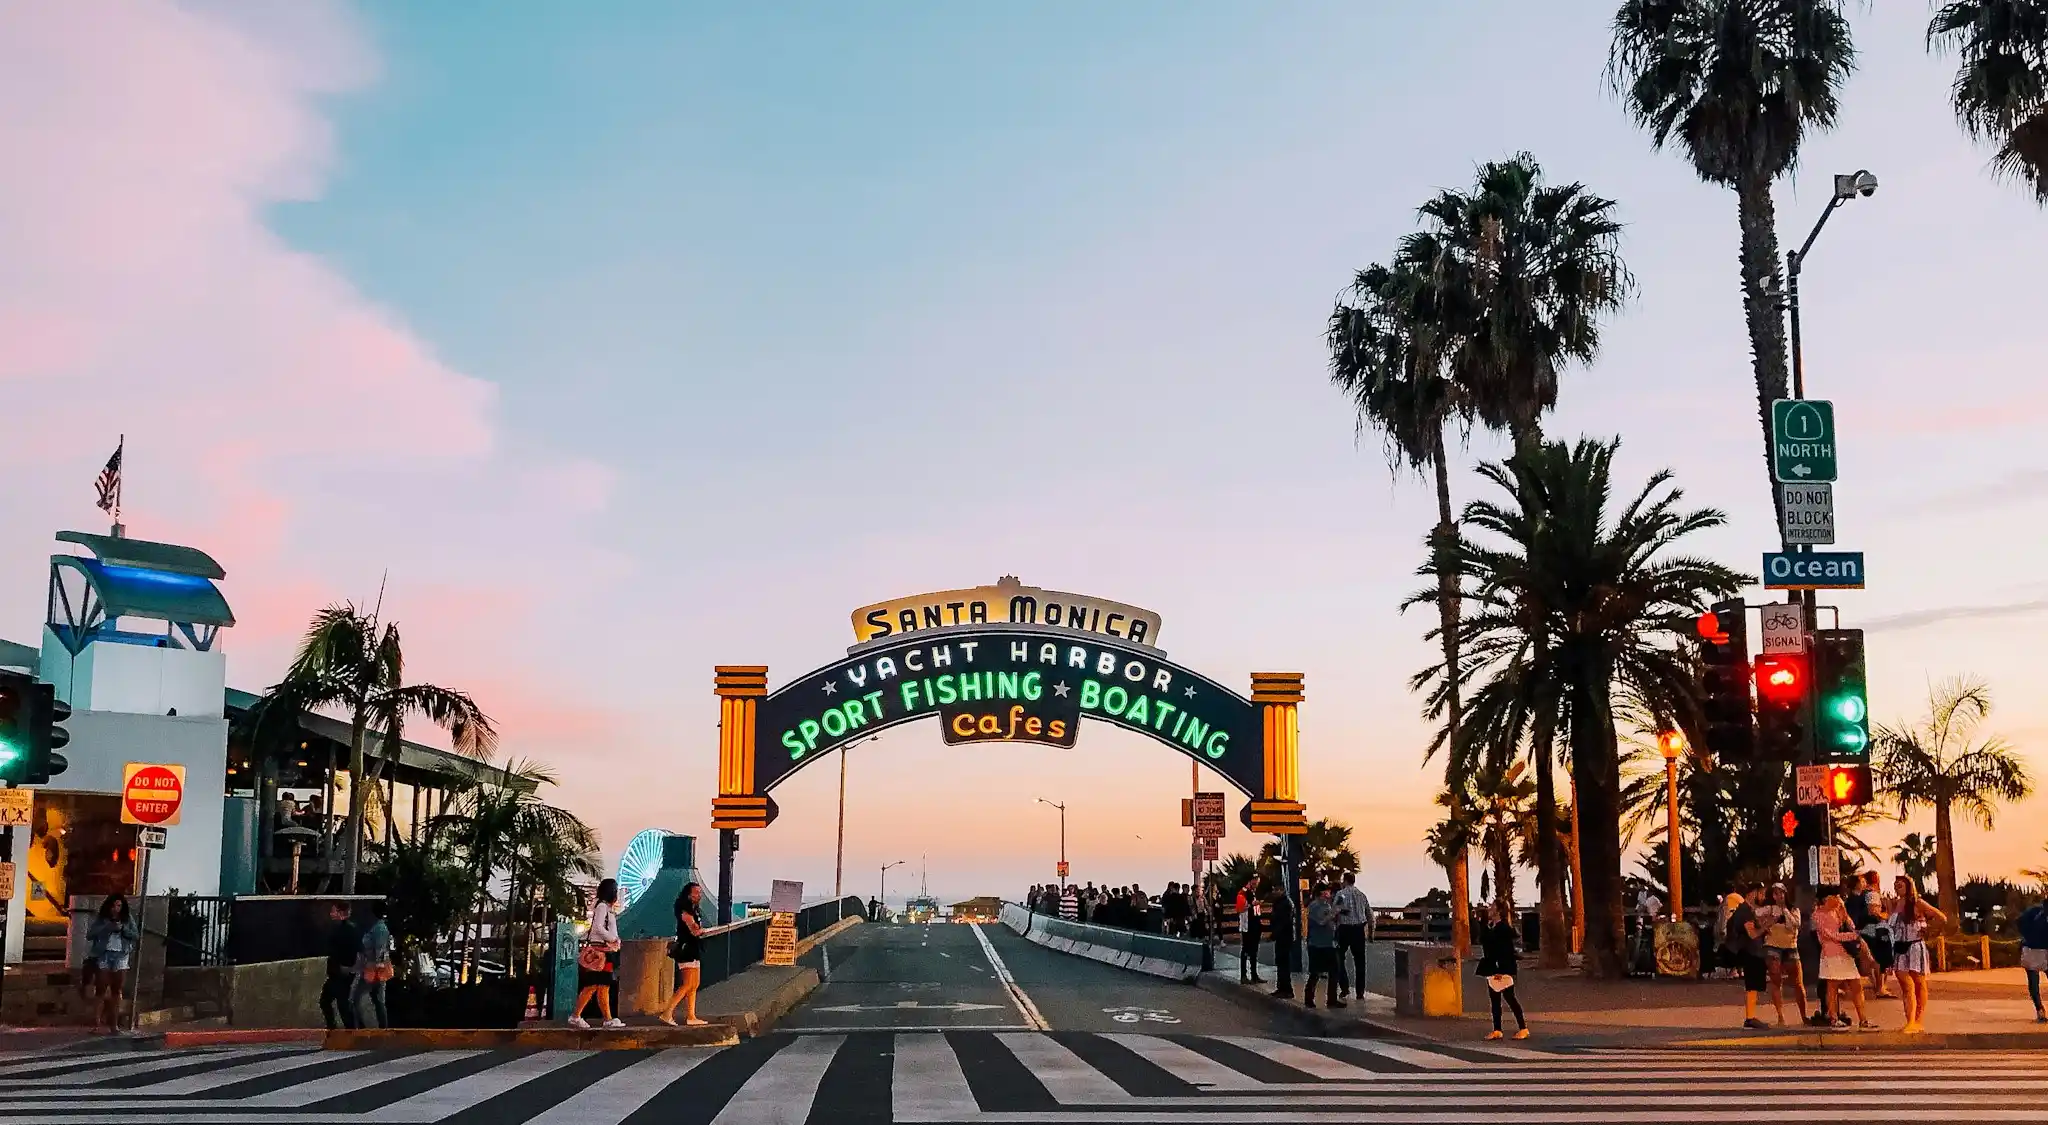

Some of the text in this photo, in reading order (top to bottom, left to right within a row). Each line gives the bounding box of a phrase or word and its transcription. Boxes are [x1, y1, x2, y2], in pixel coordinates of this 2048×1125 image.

[1801, 415, 1807, 434] 1
[1780, 443, 1831, 458] NORTH
[1786, 491, 1829, 505] DO NOT
[1787, 511, 1830, 525] BLOCK
[1787, 528, 1832, 538] INTERSECTION
[1771, 556, 1856, 578] Ocean
[866, 595, 1149, 643] SANTA MONICA
[1765, 636, 1801, 647] SIGNAL
[847, 641, 1172, 693] YACHT HARBOR
[781, 671, 1230, 760] SPORT FISHING BOATING
[134, 776, 176, 788] DO NOT
[135, 802, 169, 813] ENTER
